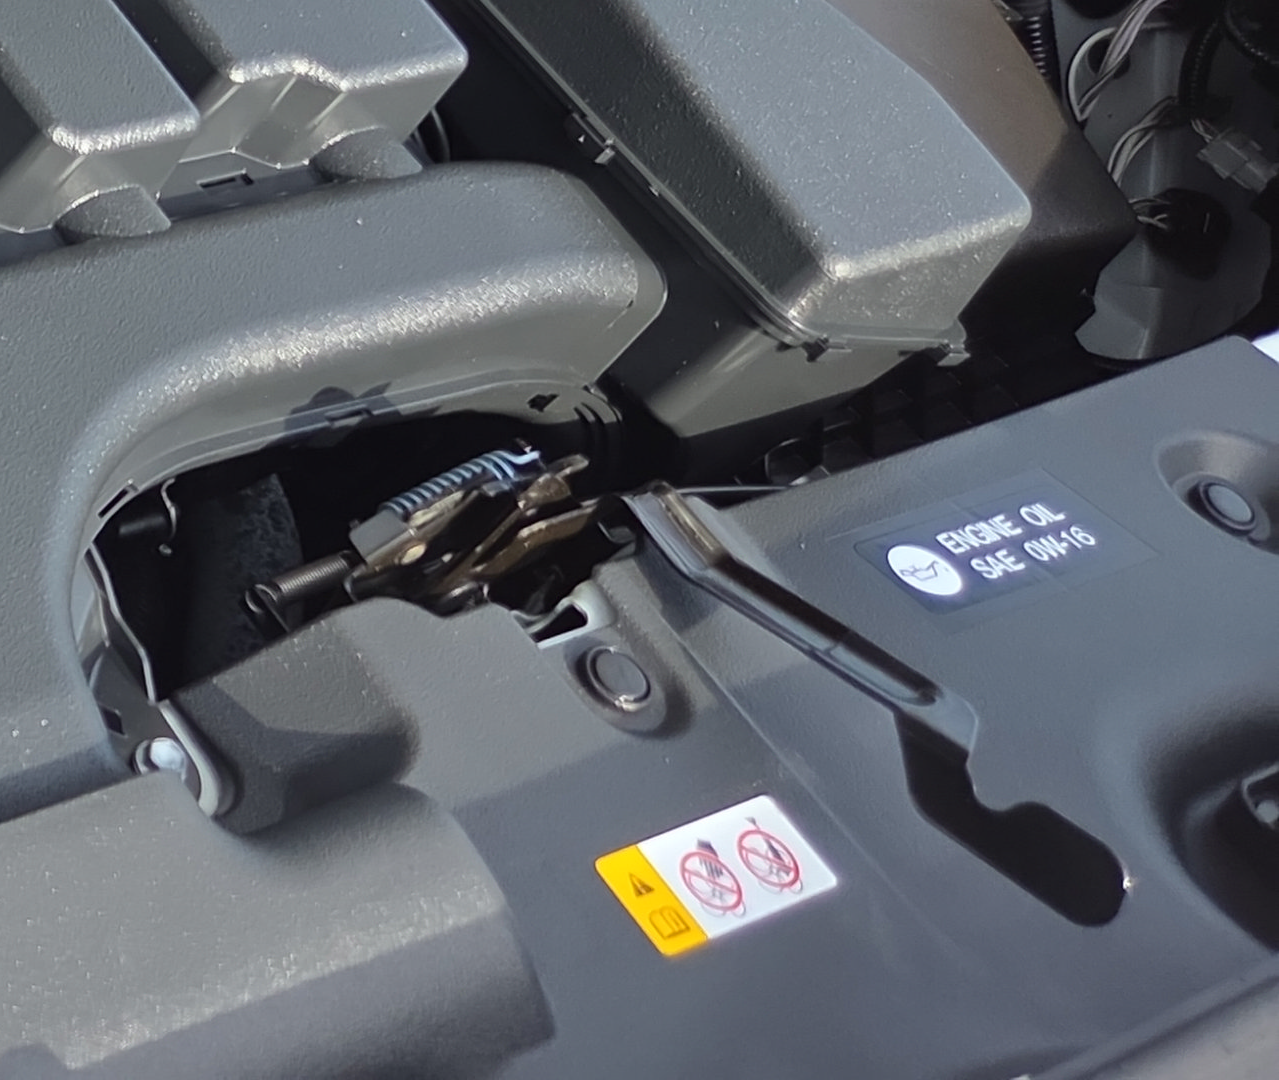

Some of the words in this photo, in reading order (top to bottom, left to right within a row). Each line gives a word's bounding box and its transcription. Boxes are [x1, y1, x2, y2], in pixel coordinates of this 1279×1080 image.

[936, 514, 1022, 554] ENGINE
[1019, 503, 1066, 526] OIL
[970, 549, 1026, 579] SAE
[1024, 525, 1097, 561] 0W-16
